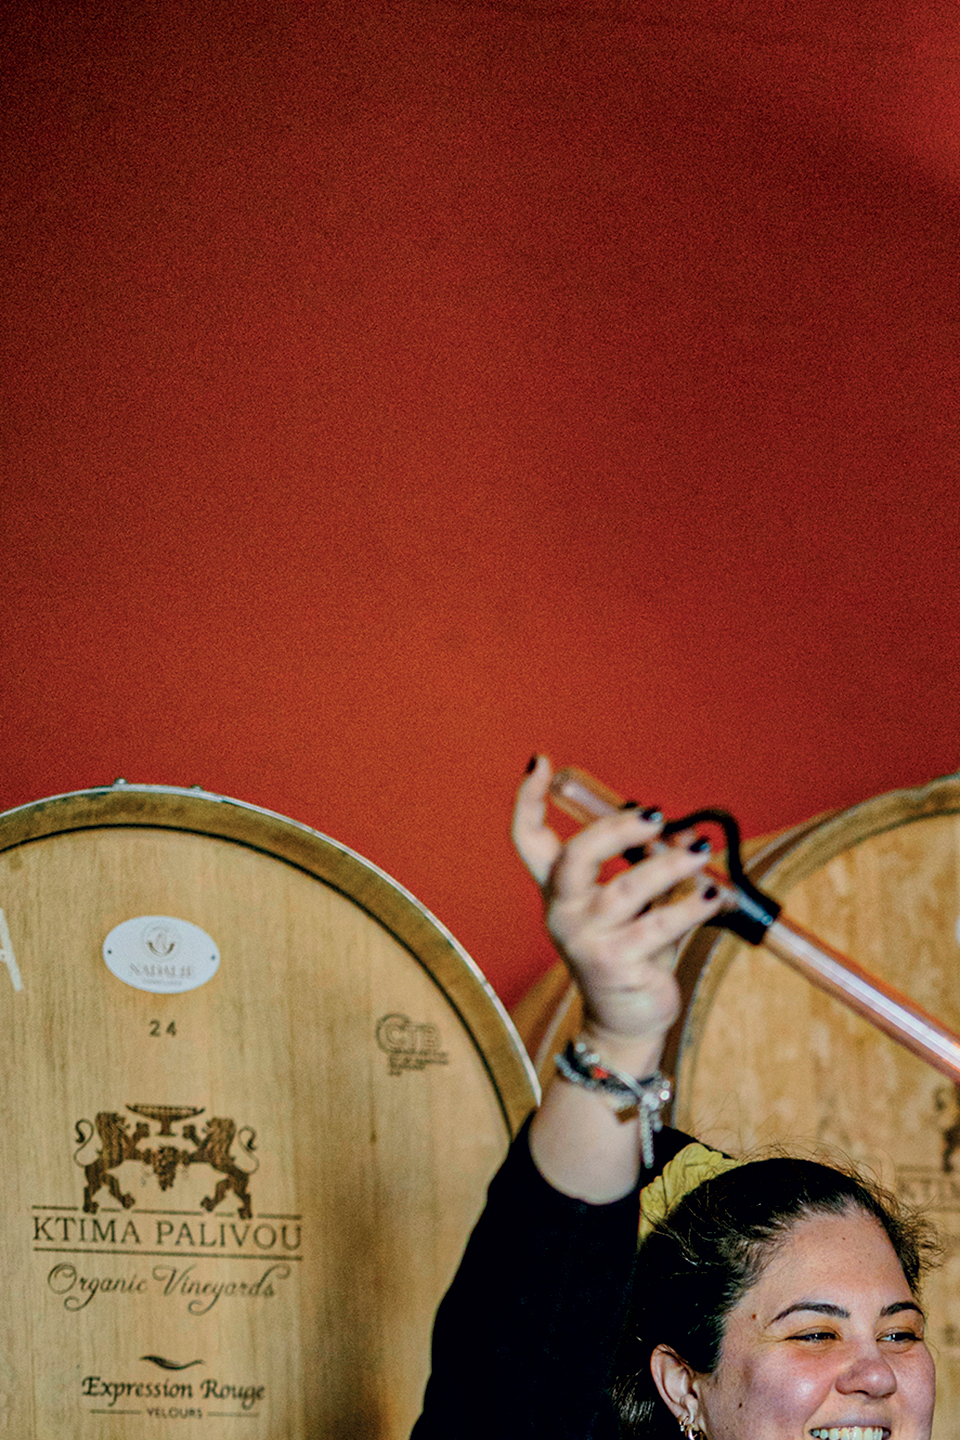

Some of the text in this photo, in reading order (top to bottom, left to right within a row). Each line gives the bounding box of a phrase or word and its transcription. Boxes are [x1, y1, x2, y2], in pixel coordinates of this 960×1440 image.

[149, 1019, 177, 1037] 24
[32, 1216, 302, 1251] KTIMA PALIVOU
[47, 1261, 291, 1316] Organic Vineyards
[81, 1375, 265, 1410] Expression Rouge
[146, 1407, 203, 1420] VELOURS
